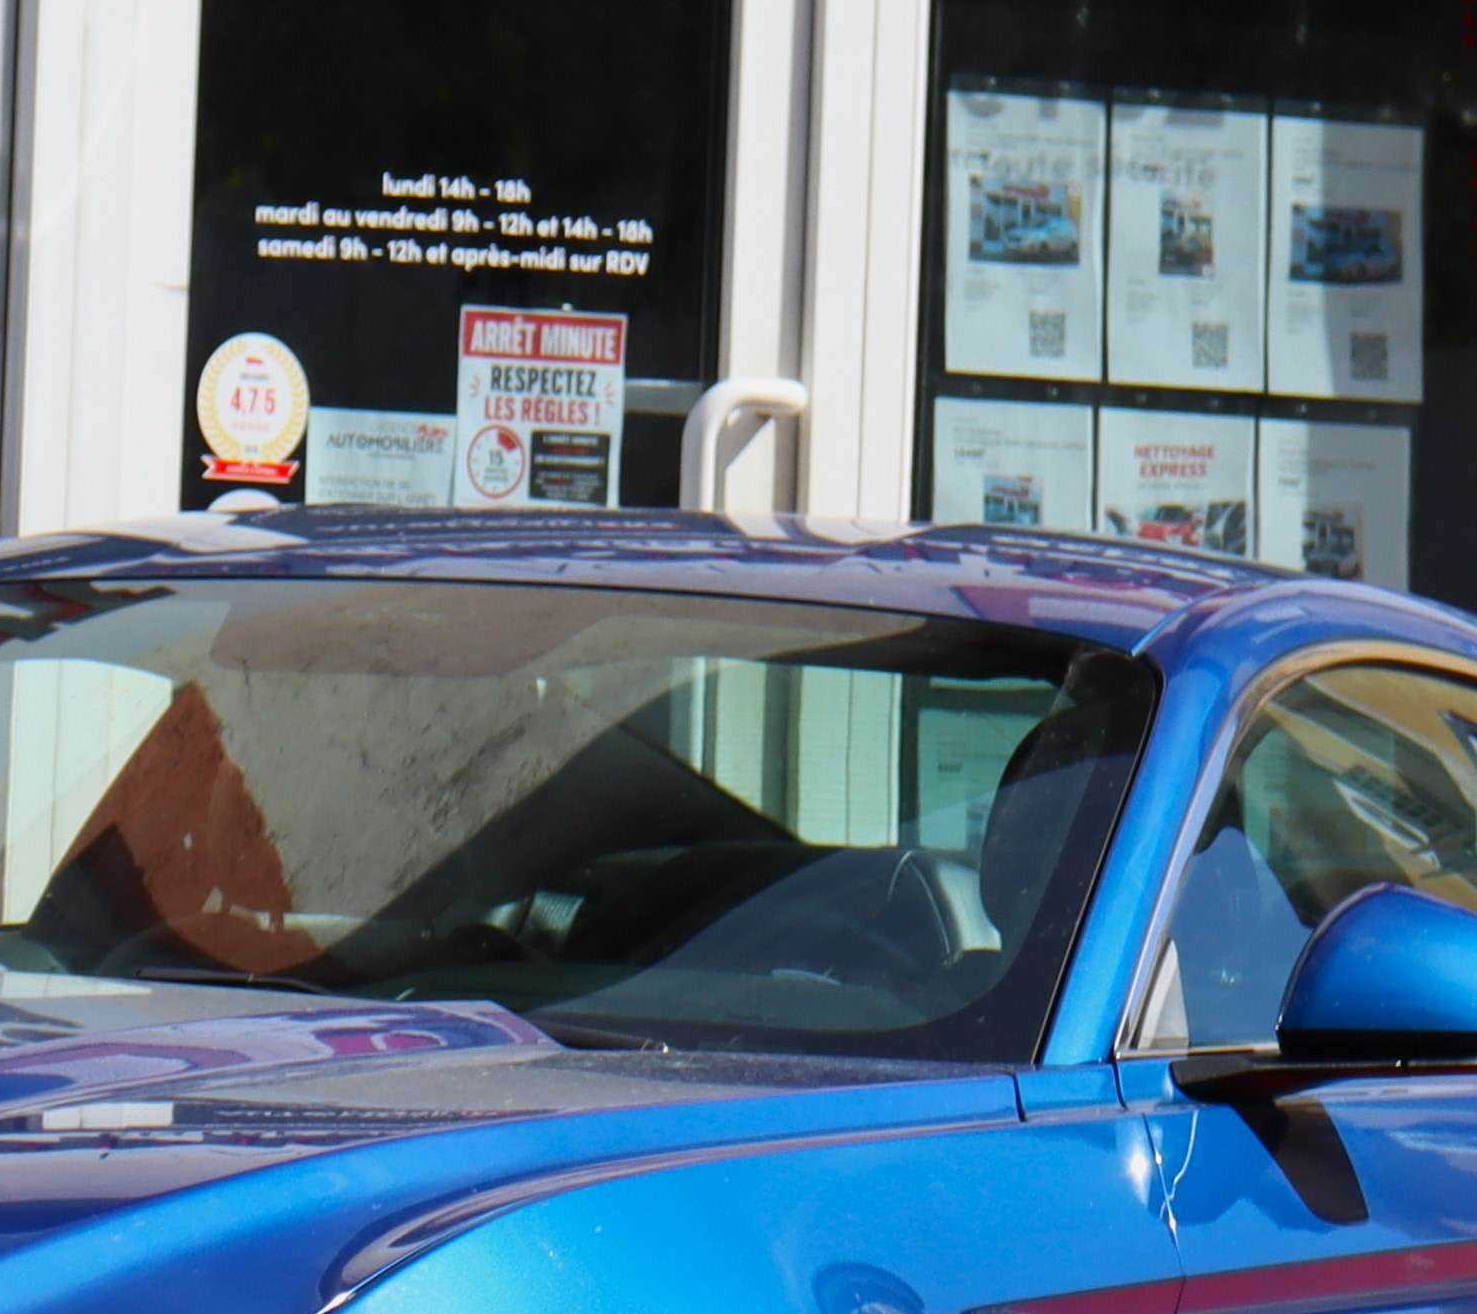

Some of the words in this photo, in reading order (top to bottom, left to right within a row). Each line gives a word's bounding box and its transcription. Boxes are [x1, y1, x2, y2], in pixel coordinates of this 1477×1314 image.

[382, 171, 435, 197] lundi
[439, 177, 475, 200] 14h
[494, 179, 531, 204] 18h
[255, 201, 319, 225] mardi
[323, 208, 351, 227] au
[354, 206, 447, 232] vendredi
[452, 209, 479, 233] 9h
[499, 211, 533, 236] 12h
[537, 215, 559, 237] et
[562, 216, 597, 240] 14h
[617, 219, 653, 243] 18h
[258, 234, 335, 260] samedi
[339, 236, 368, 260] 9h
[387, 239, 422, 263] 12h
[426, 243, 448, 264] et
[451, 244, 566, 272] après-midi
[569, 253, 602, 273] sur
[606, 250, 649, 276] RDV
[470, 318, 535, 355] ARRÊT
[541, 322, 616, 361] MINUTE
[490, 365, 597, 398] RESPECTEZ
[484, 397, 518, 421] LES
